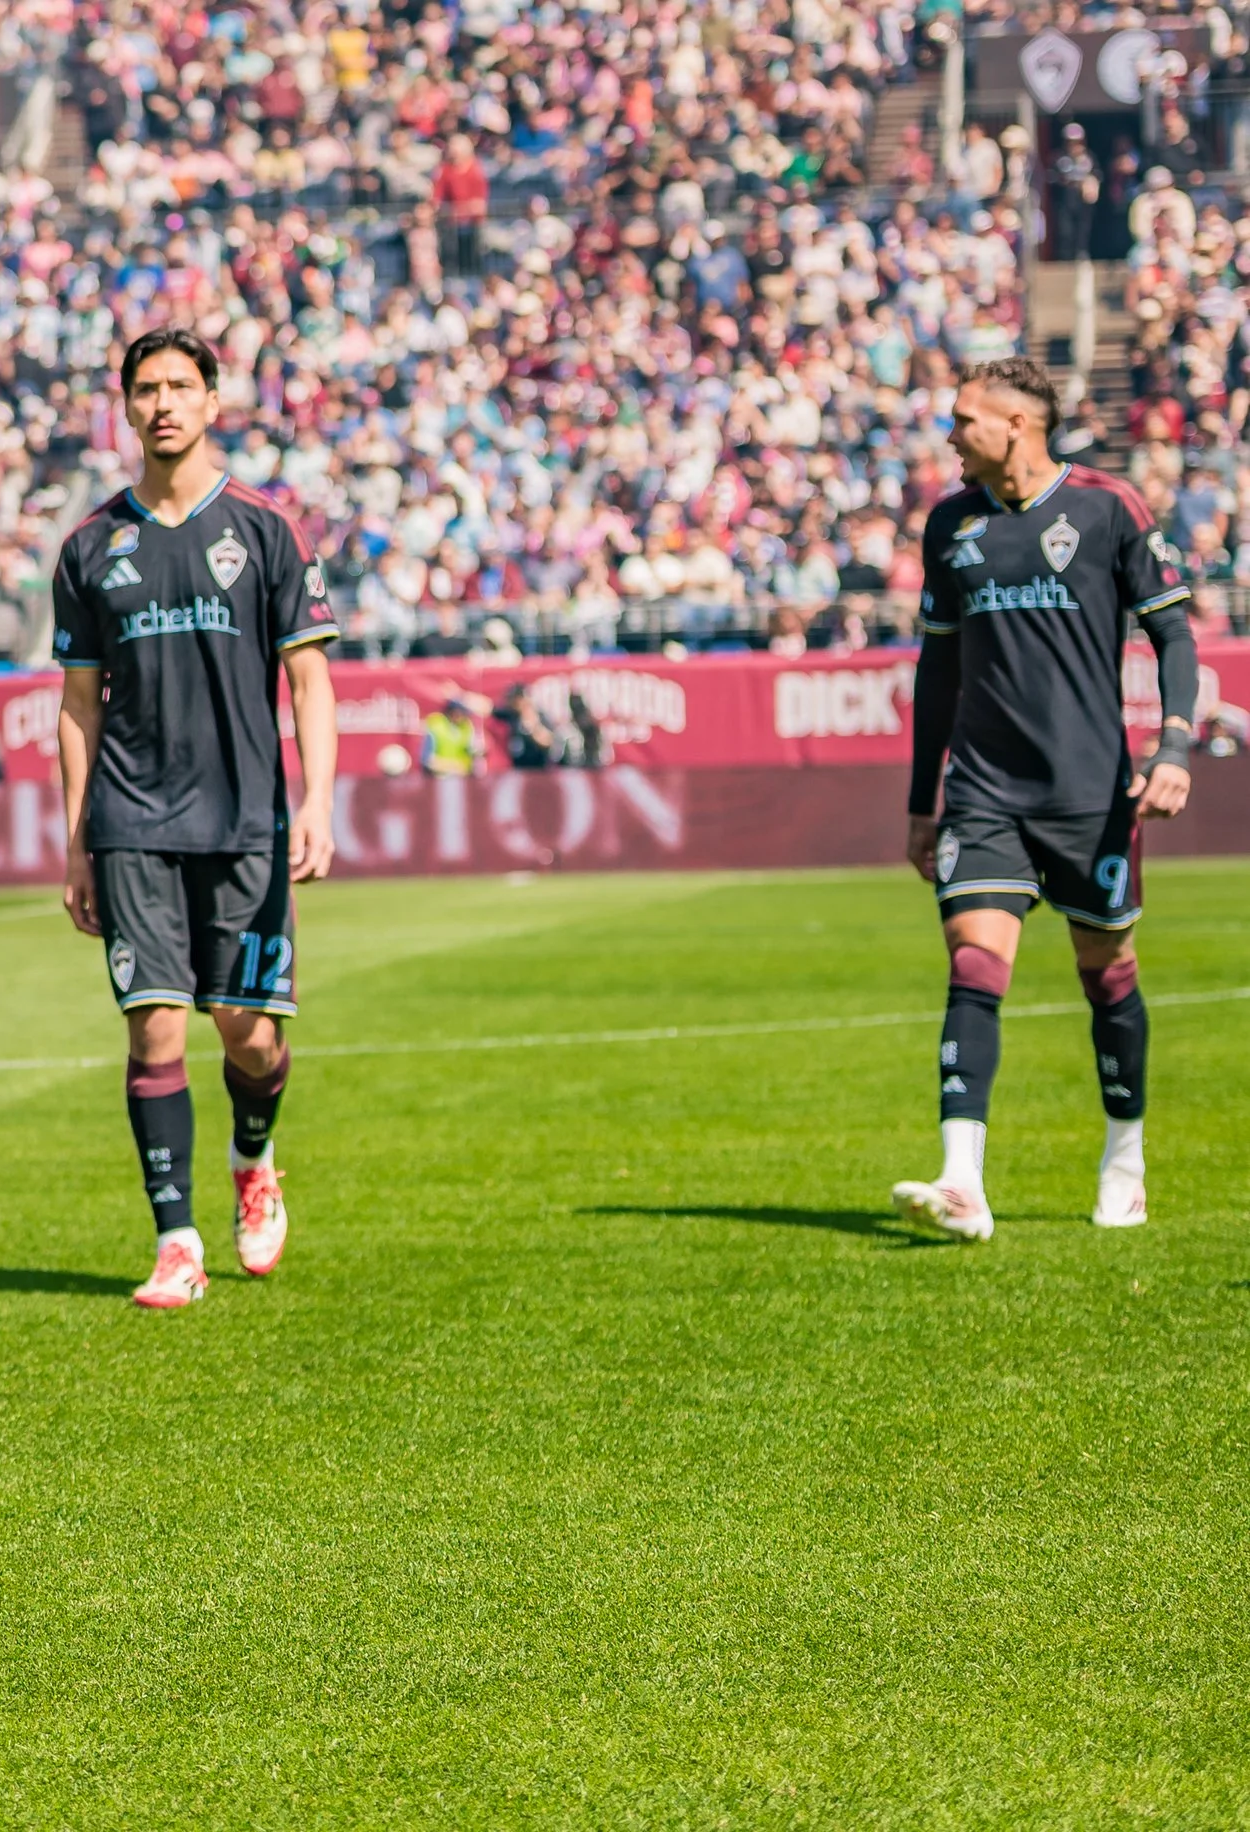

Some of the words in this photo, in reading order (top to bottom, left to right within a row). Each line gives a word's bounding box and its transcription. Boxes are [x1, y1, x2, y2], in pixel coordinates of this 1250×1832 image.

[773, 660, 918, 739] DICK'
[1095, 855, 1129, 909] 9
[238, 931, 293, 993] 12
